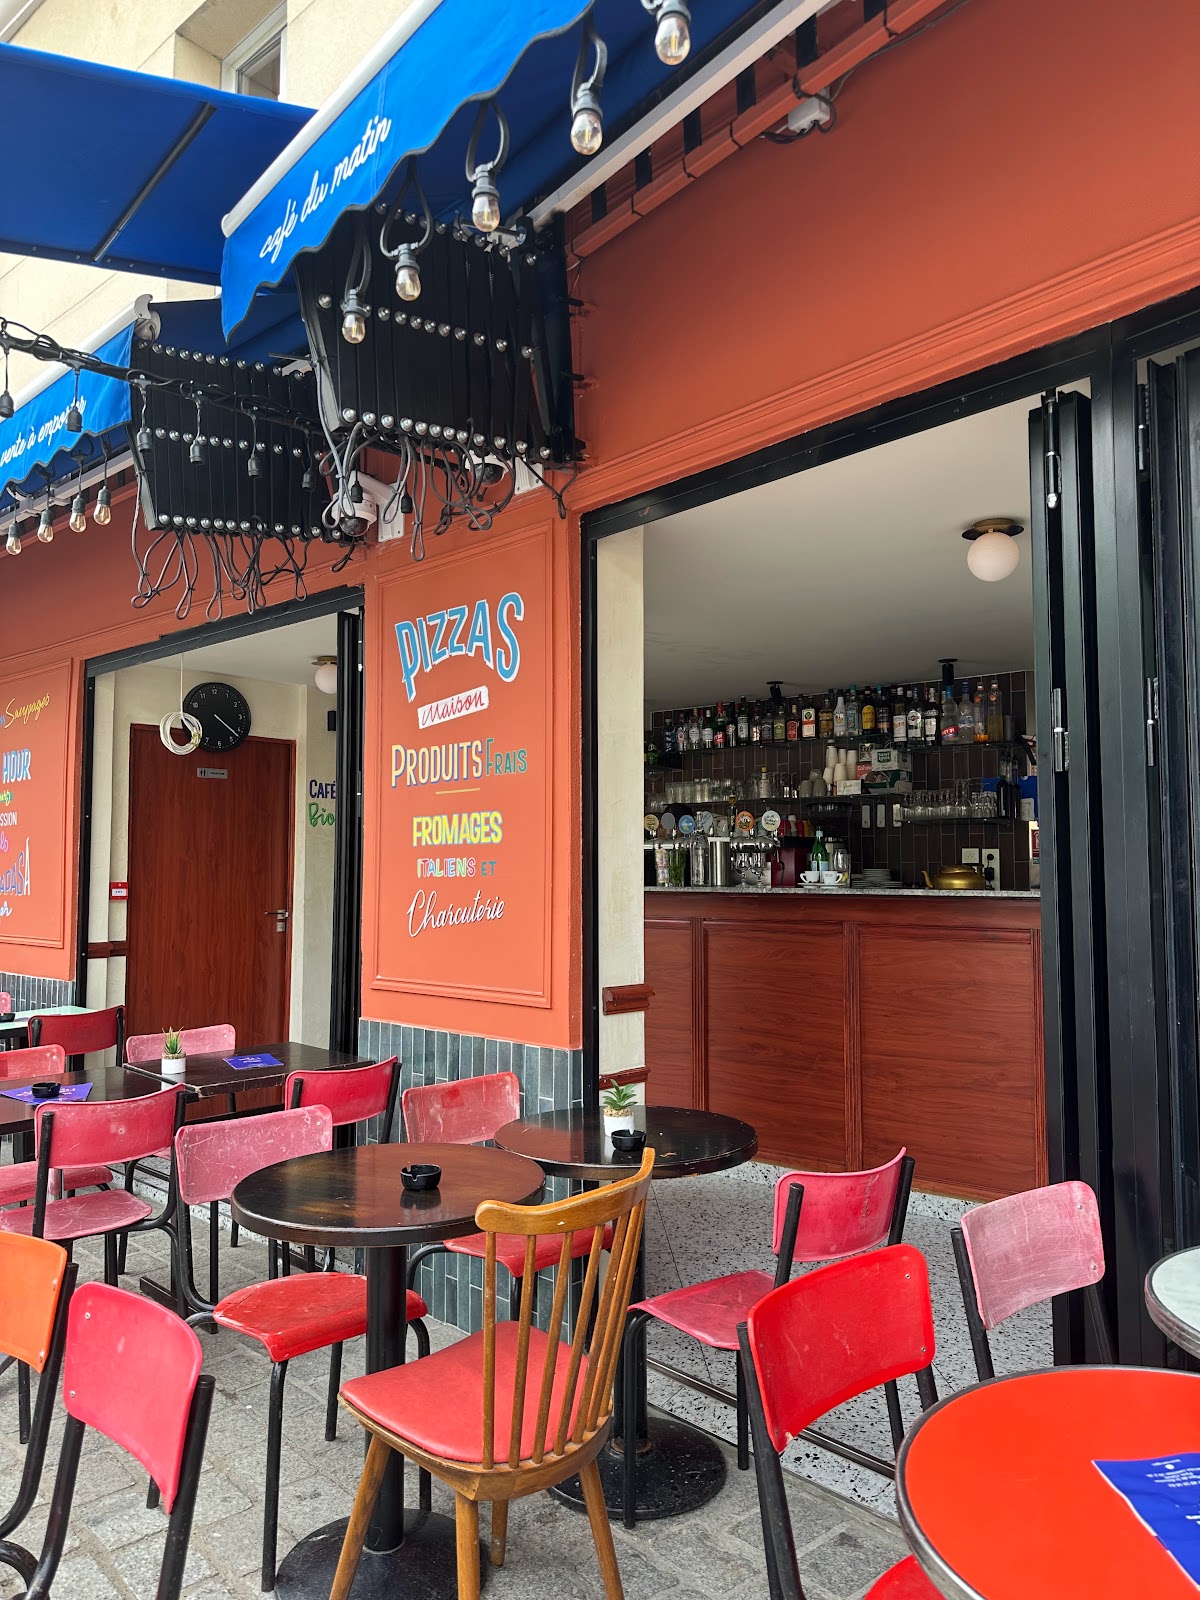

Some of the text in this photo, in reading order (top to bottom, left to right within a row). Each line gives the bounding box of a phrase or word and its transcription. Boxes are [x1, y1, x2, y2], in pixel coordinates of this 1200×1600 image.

[259, 115, 392, 264] café du matin
[27, 425, 37, 449] à
[394, 591, 525, 702] PIZZAS
[421, 690, 485, 726] Maison
[2, 748, 31, 784] HOUR
[309, 779, 336, 799] CAFÉ
[308, 802, 336, 828] Bio
[412, 810, 503, 847] FROMAGES
[416, 856, 497, 879] ITALIENS ET
[406, 888, 505, 938] Charcuterie
